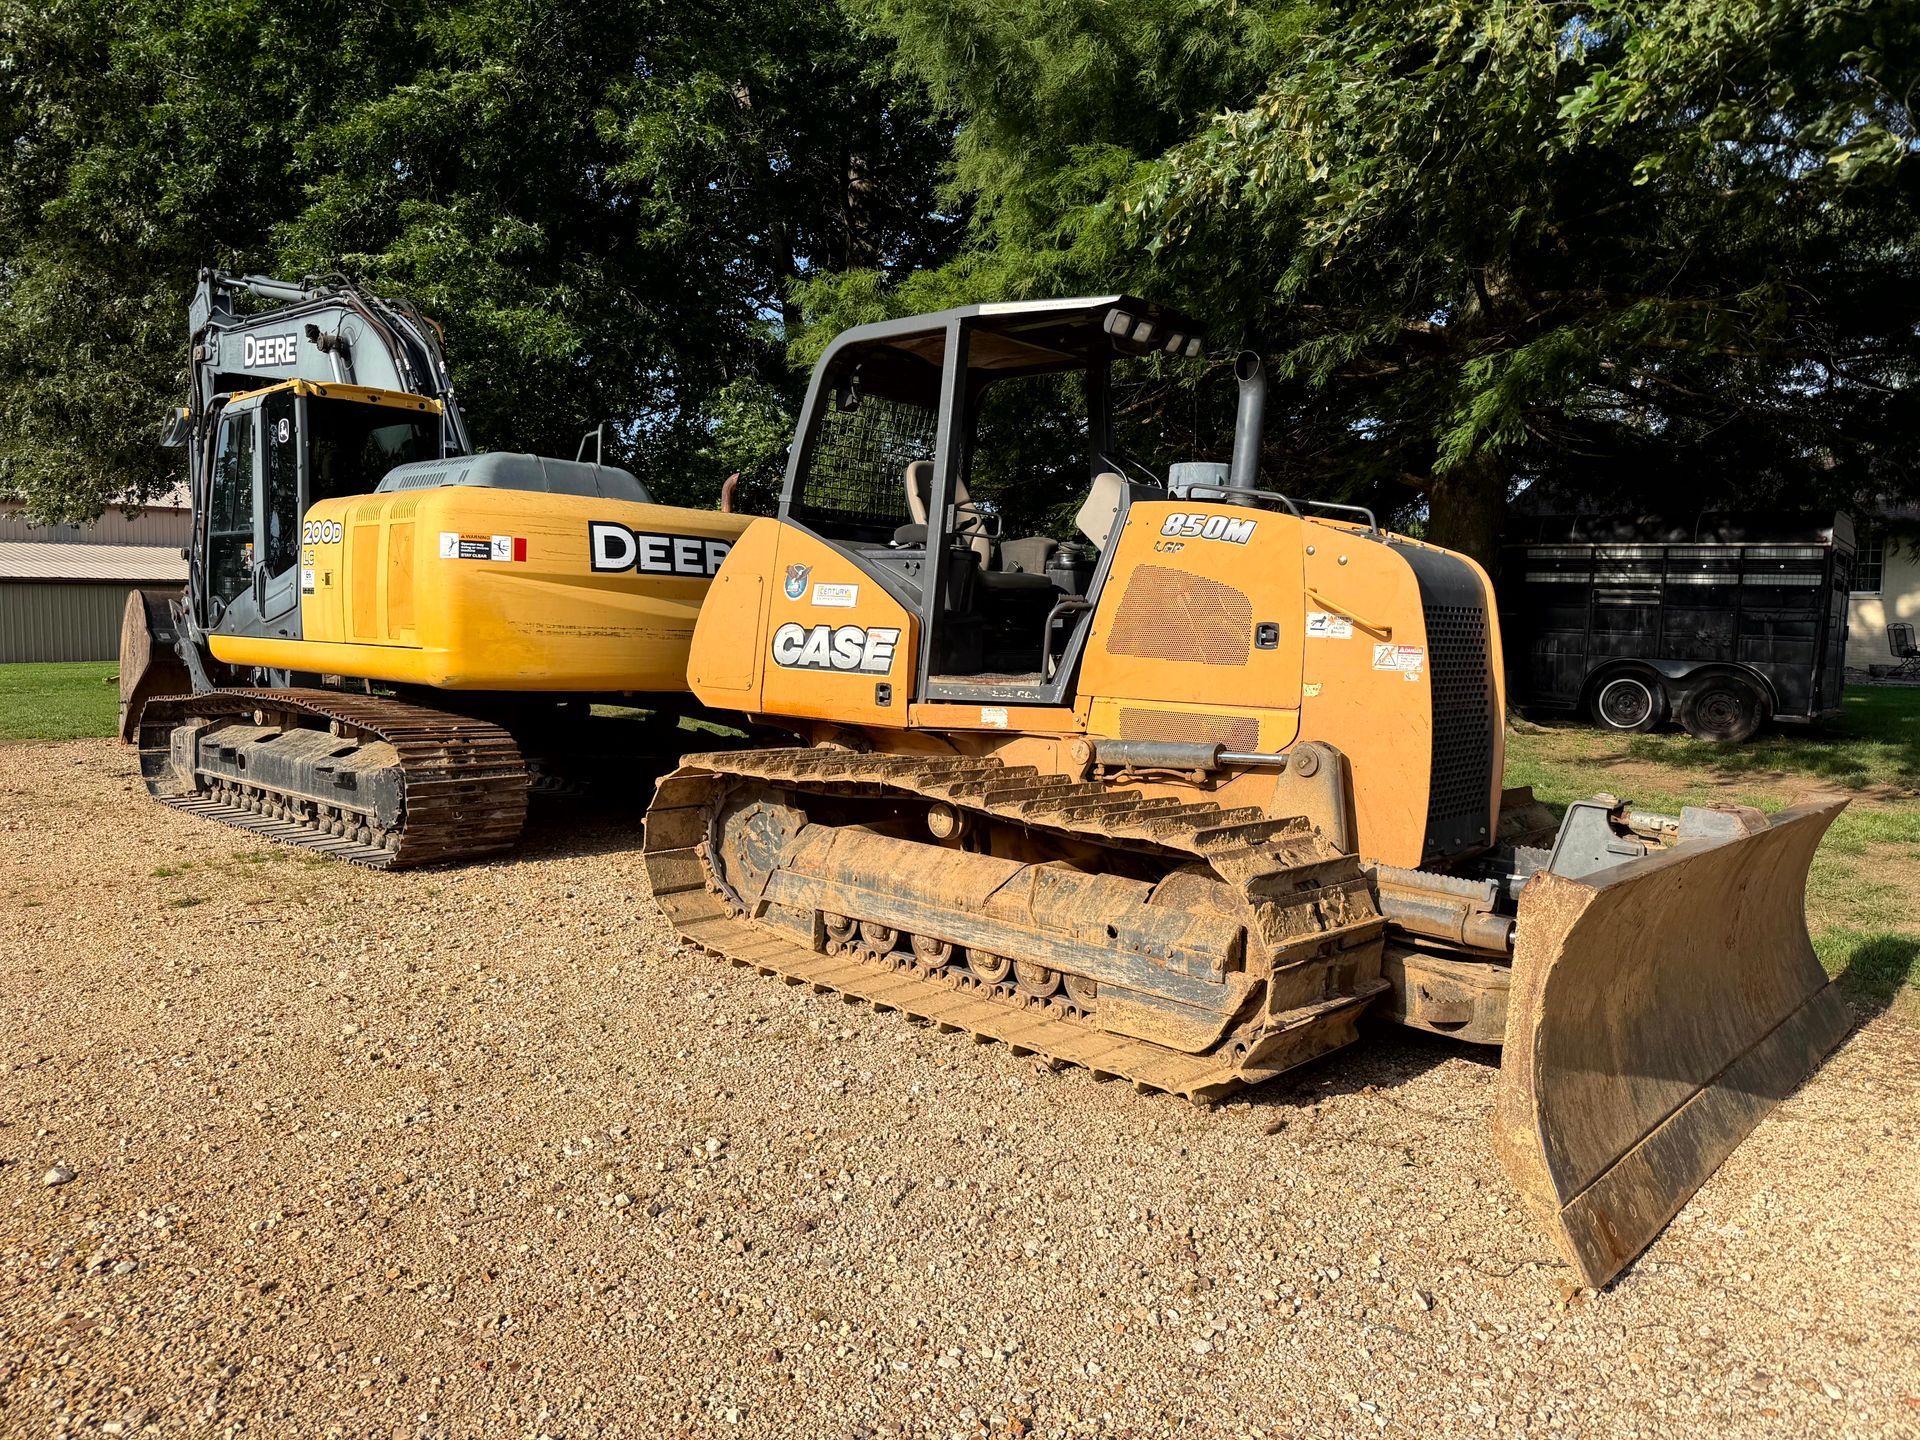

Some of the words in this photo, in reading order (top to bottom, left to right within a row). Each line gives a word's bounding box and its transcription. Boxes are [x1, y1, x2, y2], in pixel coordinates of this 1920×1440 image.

[244, 333, 297, 369] DEERE
[303, 520, 342, 545] 200D
[1160, 513, 1257, 544] 850M
[589, 521, 733, 576] DEER
[773, 622, 900, 674] CASE
